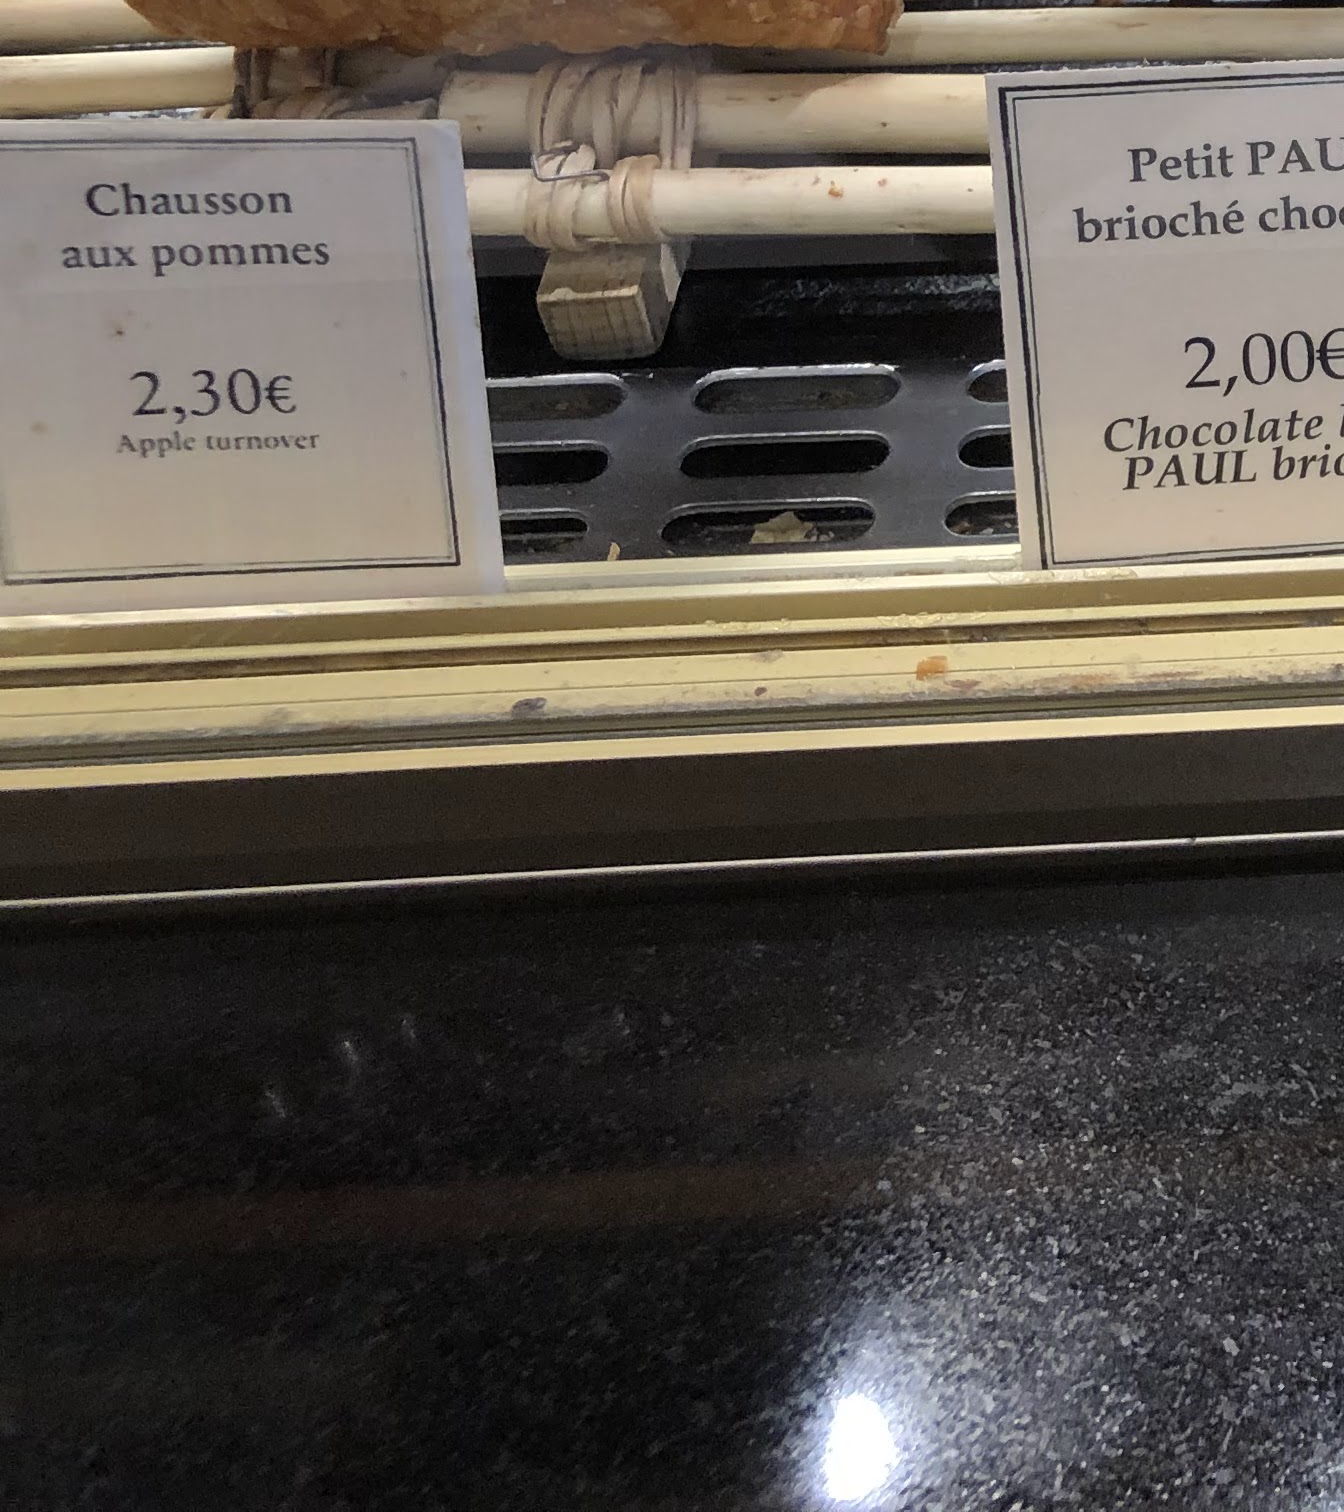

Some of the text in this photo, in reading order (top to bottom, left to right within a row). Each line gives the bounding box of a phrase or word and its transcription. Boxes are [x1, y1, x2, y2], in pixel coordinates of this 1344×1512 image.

[1129, 144, 1233, 183] Petit
[85, 182, 293, 217] Chausson
[1073, 200, 1244, 243] brioché
[62, 239, 330, 277] aux pommes
[129, 367, 297, 424] 2,30€
[117, 431, 320, 457] Apple turnover
[1103, 409, 1323, 453] Chocolate
[1122, 450, 1258, 491] PAUL
